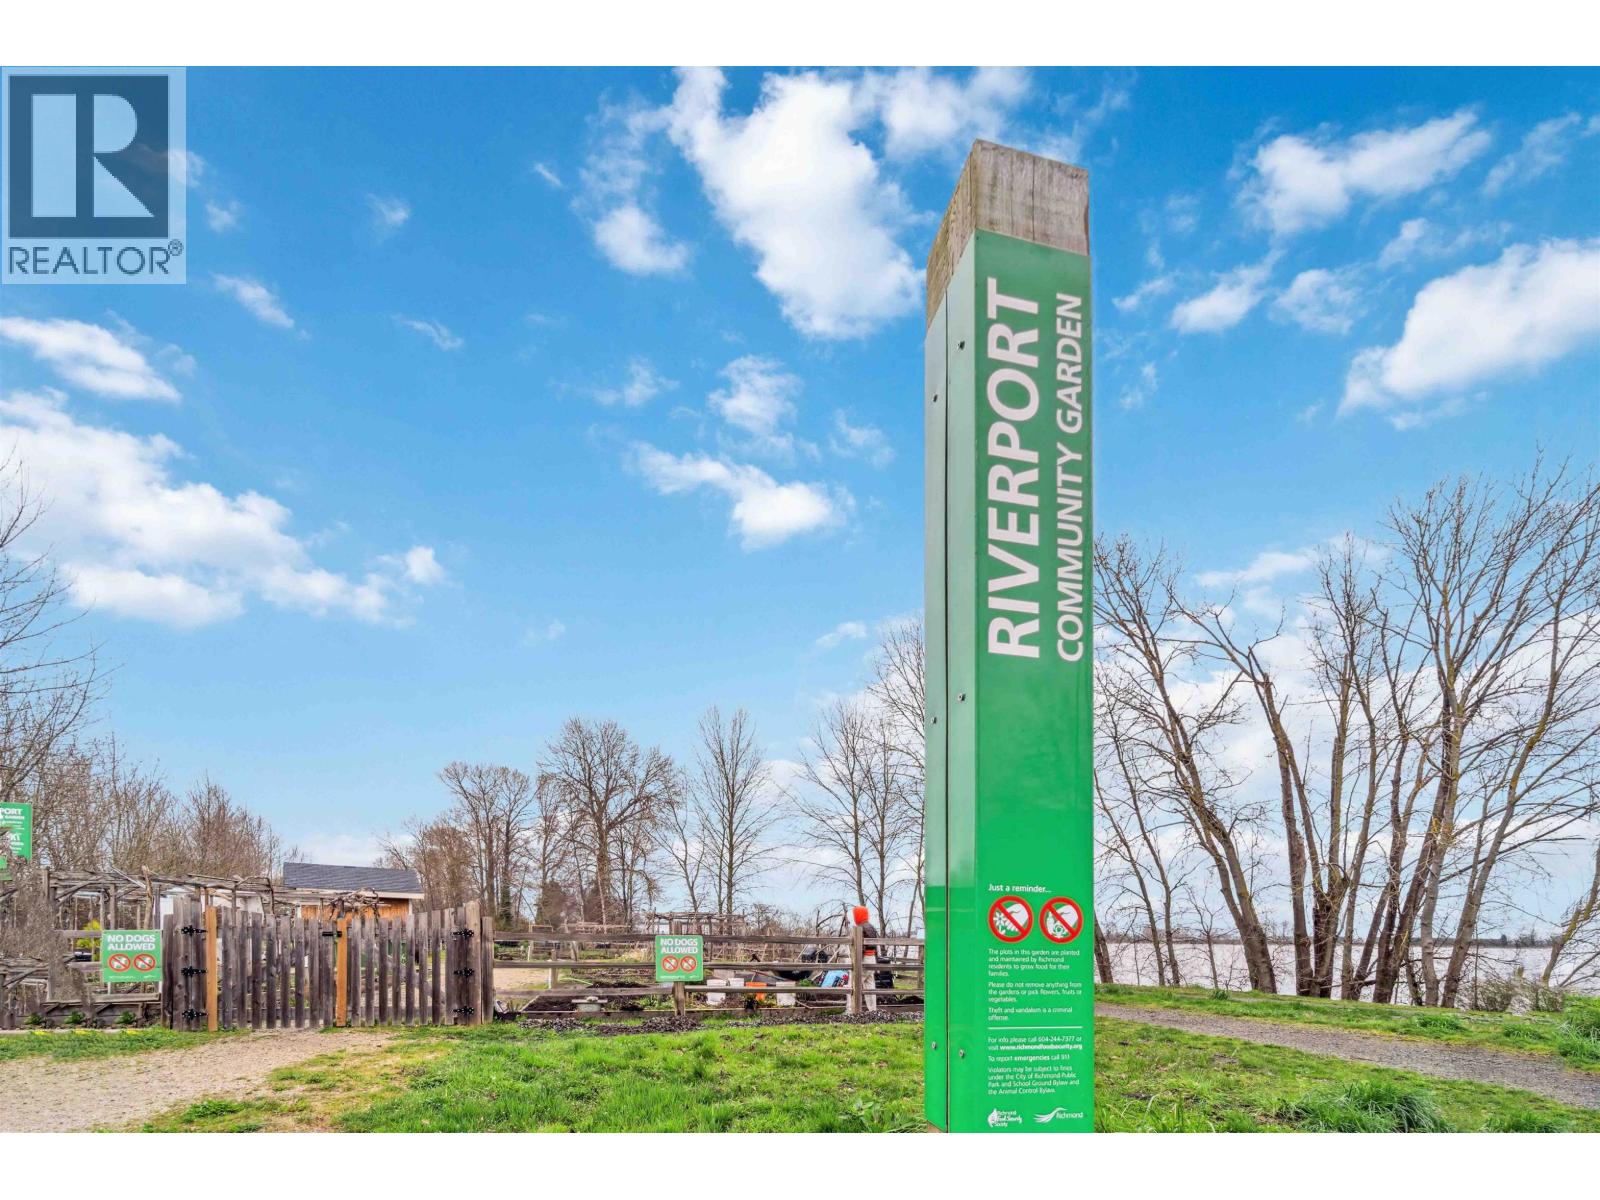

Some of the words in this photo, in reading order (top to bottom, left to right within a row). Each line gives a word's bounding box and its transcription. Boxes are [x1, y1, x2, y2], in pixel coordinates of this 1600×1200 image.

[1056, 292, 1083, 434] GARDEN
[987, 277, 1040, 658] RIVERPORT
[1056, 442, 1084, 662] COMMUNITY
[108, 934, 124, 942] NO
[126, 934, 156, 942] DOGS
